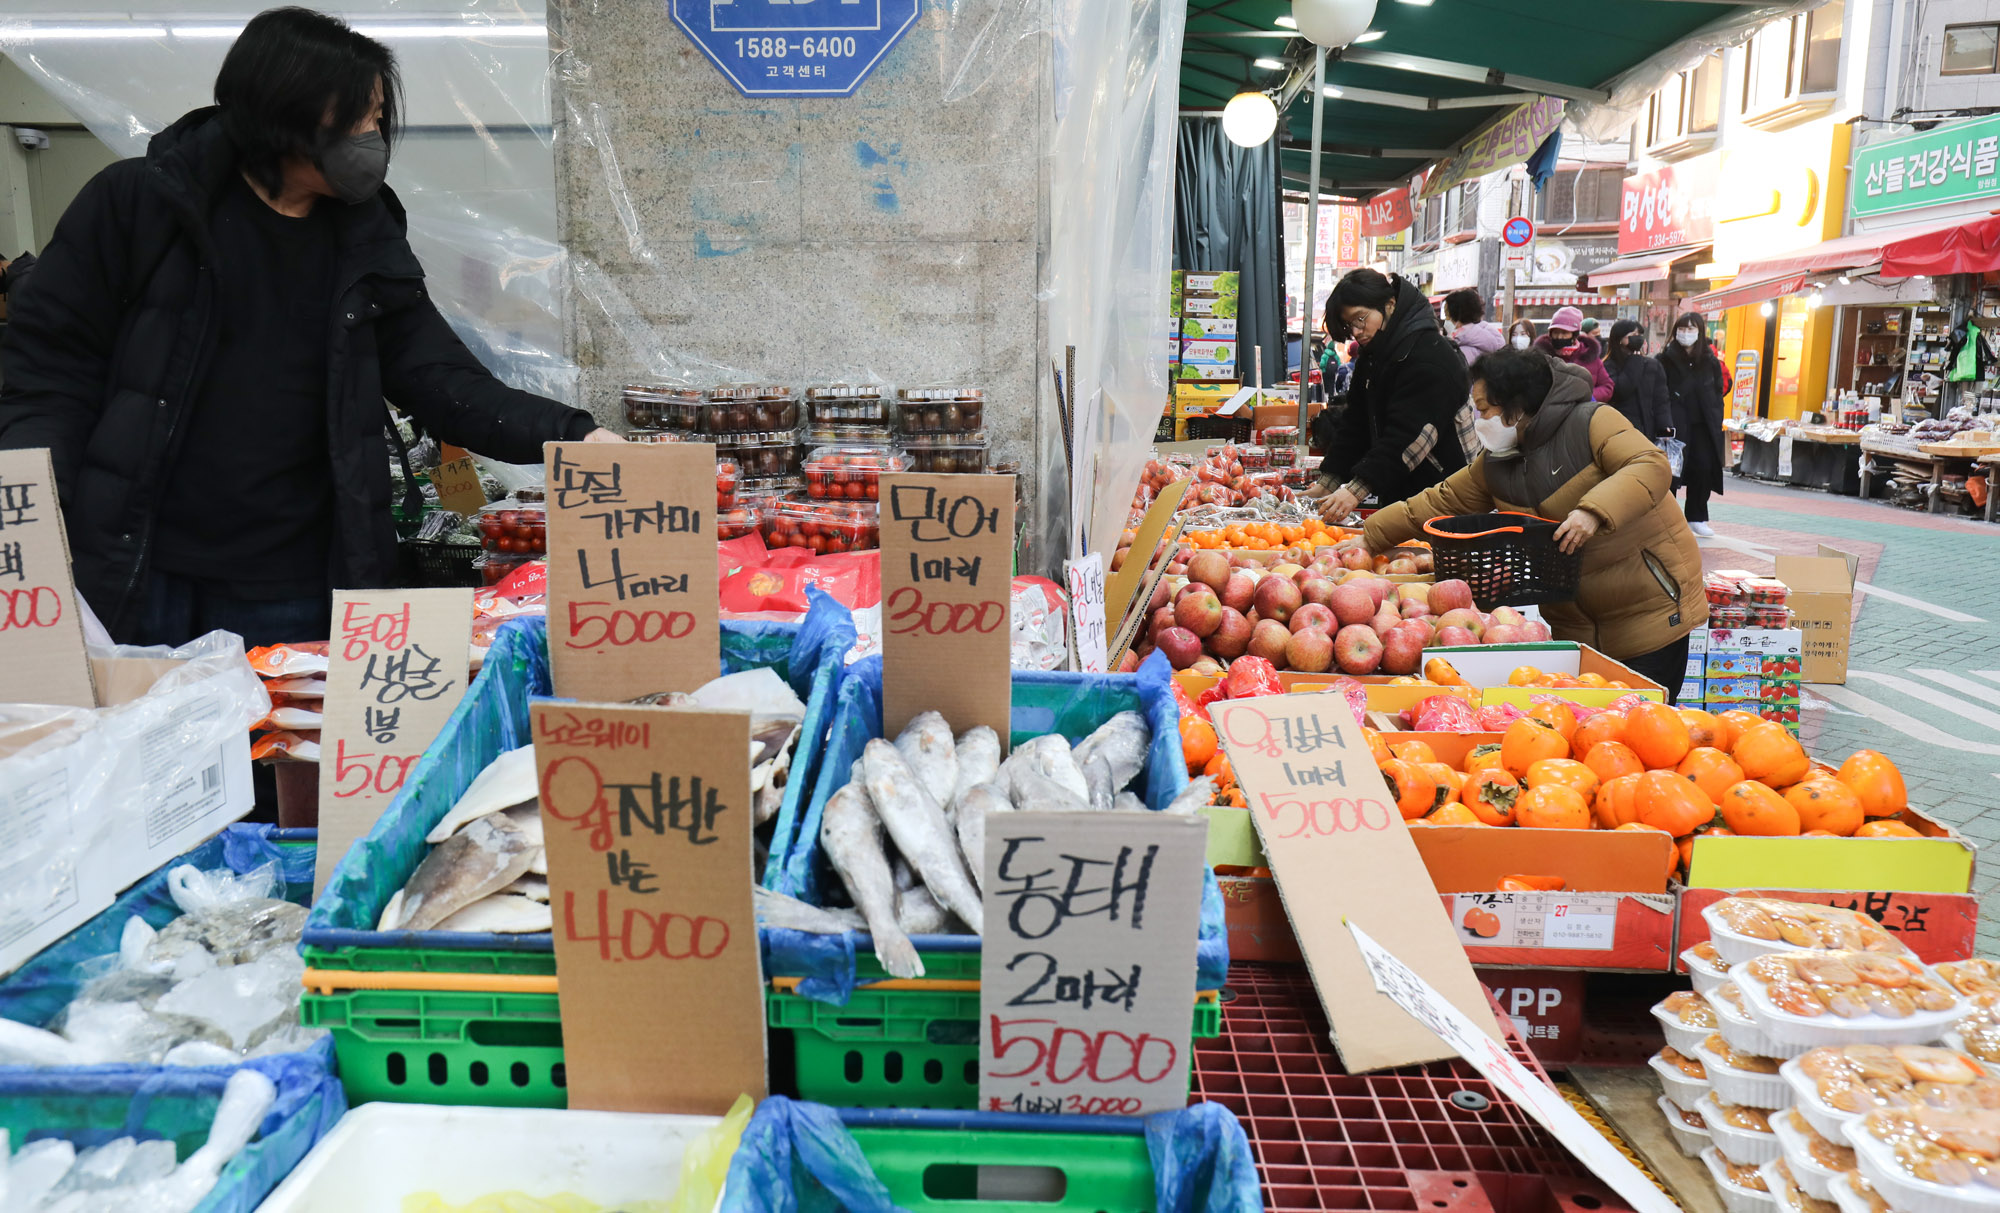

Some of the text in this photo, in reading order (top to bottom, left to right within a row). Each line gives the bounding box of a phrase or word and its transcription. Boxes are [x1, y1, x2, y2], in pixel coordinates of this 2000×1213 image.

[734, 36, 856, 58] 1588-6400
[766, 65, 826, 78] 고객센터
[1341, 198, 1355, 259] 마치통닭
[553, 447, 628, 509] 손질
[580, 500, 700, 540] 가자미
[890, 484, 999, 542] 민어
[910, 552, 981, 586] 1마리
[342, 602, 410, 661] 통영
[360, 643, 456, 703] 생굴
[540, 712, 650, 750] 노르웨이
[1282, 760, 1347, 787] 1마리
[1259, 792, 1391, 839] 5.000
[994, 837, 1160, 940] 동태
[1555, 905, 1568, 917] 27
[1005, 951, 1142, 1013] 2마리
[987, 1014, 1177, 1087] 5.000
